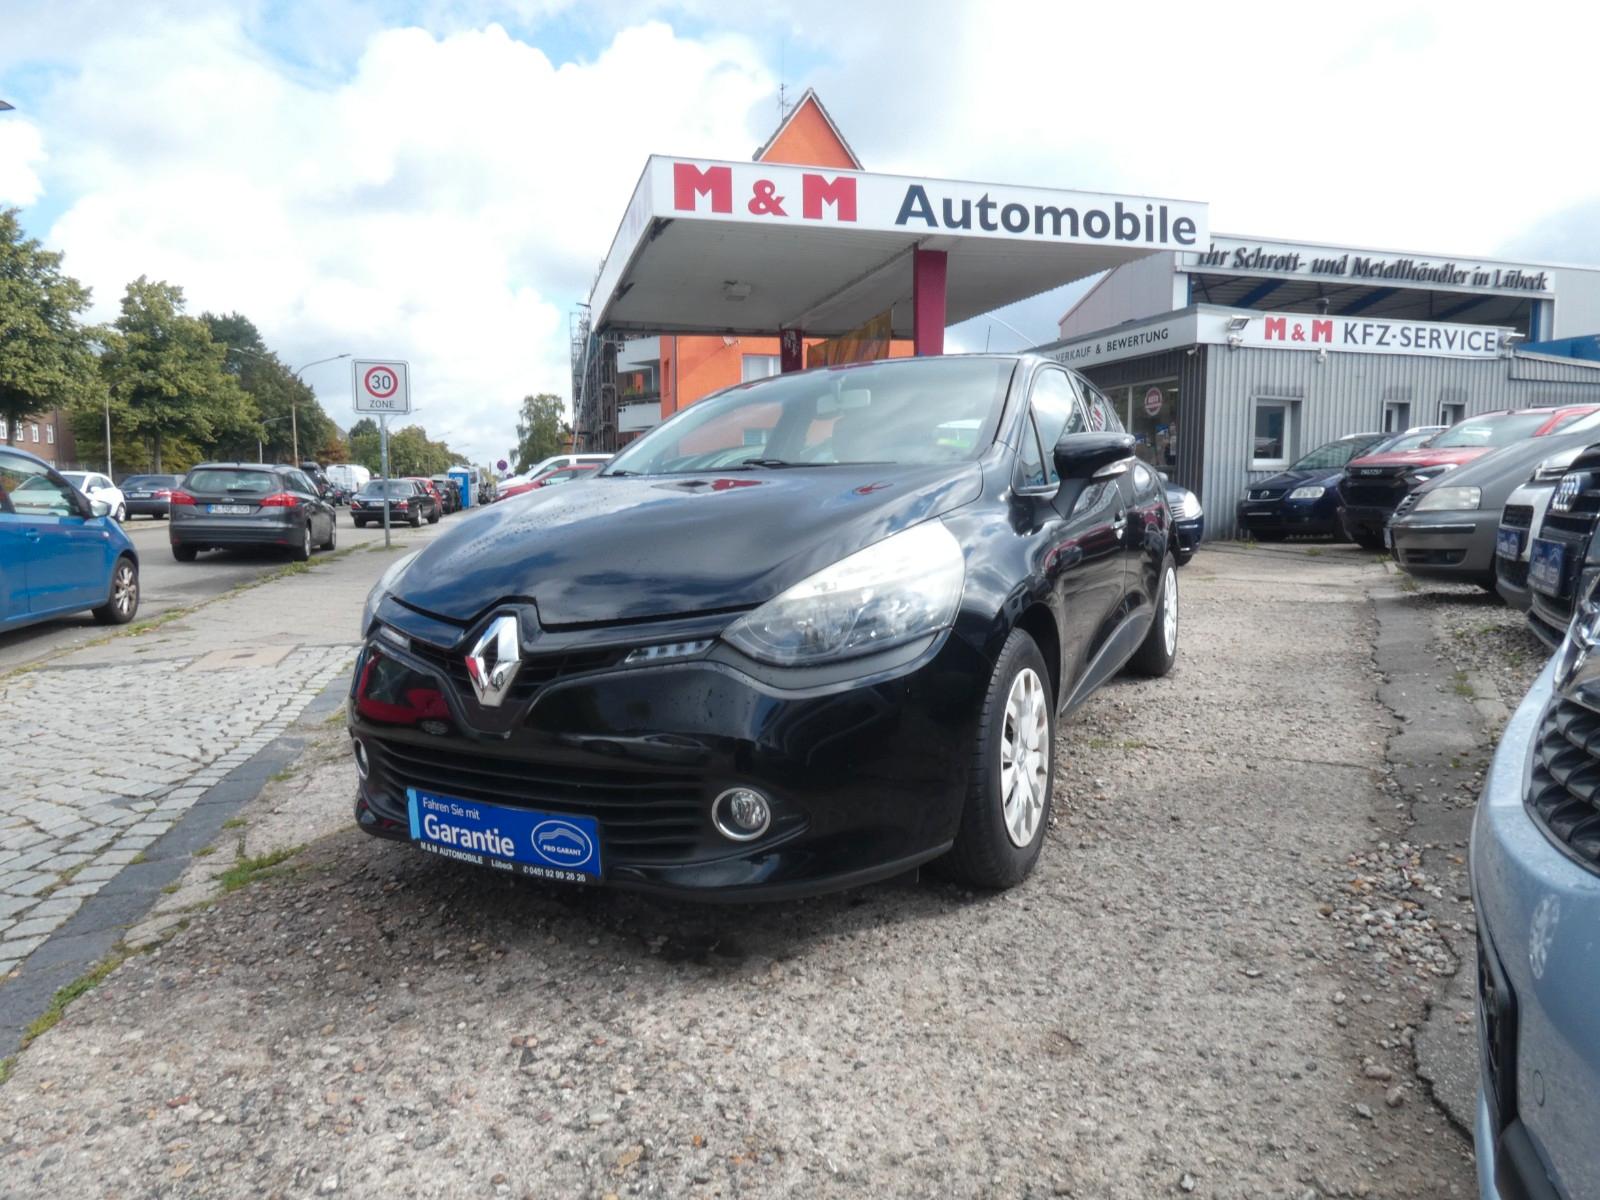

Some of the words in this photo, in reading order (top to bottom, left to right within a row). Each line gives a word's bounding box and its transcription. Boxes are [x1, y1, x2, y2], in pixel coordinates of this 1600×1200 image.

[674, 163, 732, 214] M
[748, 179, 789, 217] &
[802, 173, 857, 222] M
[895, 184, 1197, 245] Automobile
[1233, 246, 1306, 272] Schrott-
[1311, 253, 1348, 275] und
[1352, 256, 1469, 285] Metallhändler
[1473, 265, 1490, 287] in
[1494, 268, 1548, 291] Lübeck
[1095, 344, 1102, 355] &
[1106, 327, 1169, 352] BEWERTUNG
[1264, 317, 1286, 341] M
[1291, 323, 1305, 342] &
[1311, 319, 1333, 343] M
[371, 374, 391, 390] 30
[369, 399, 395, 409] ZONE
[422, 796, 450, 814] Fahren
[451, 803, 464, 817] Sie
[466, 807, 480, 821] mit
[424, 813, 515, 857] Garantie
[420, 841, 427, 850] M
[431, 844, 438, 853] M
[439, 847, 483, 865] AUTOMOBILE
[491, 858, 514, 871] Lübeck
[543, 844, 556, 852] PRO
[557, 846, 582, 856] GARANT
